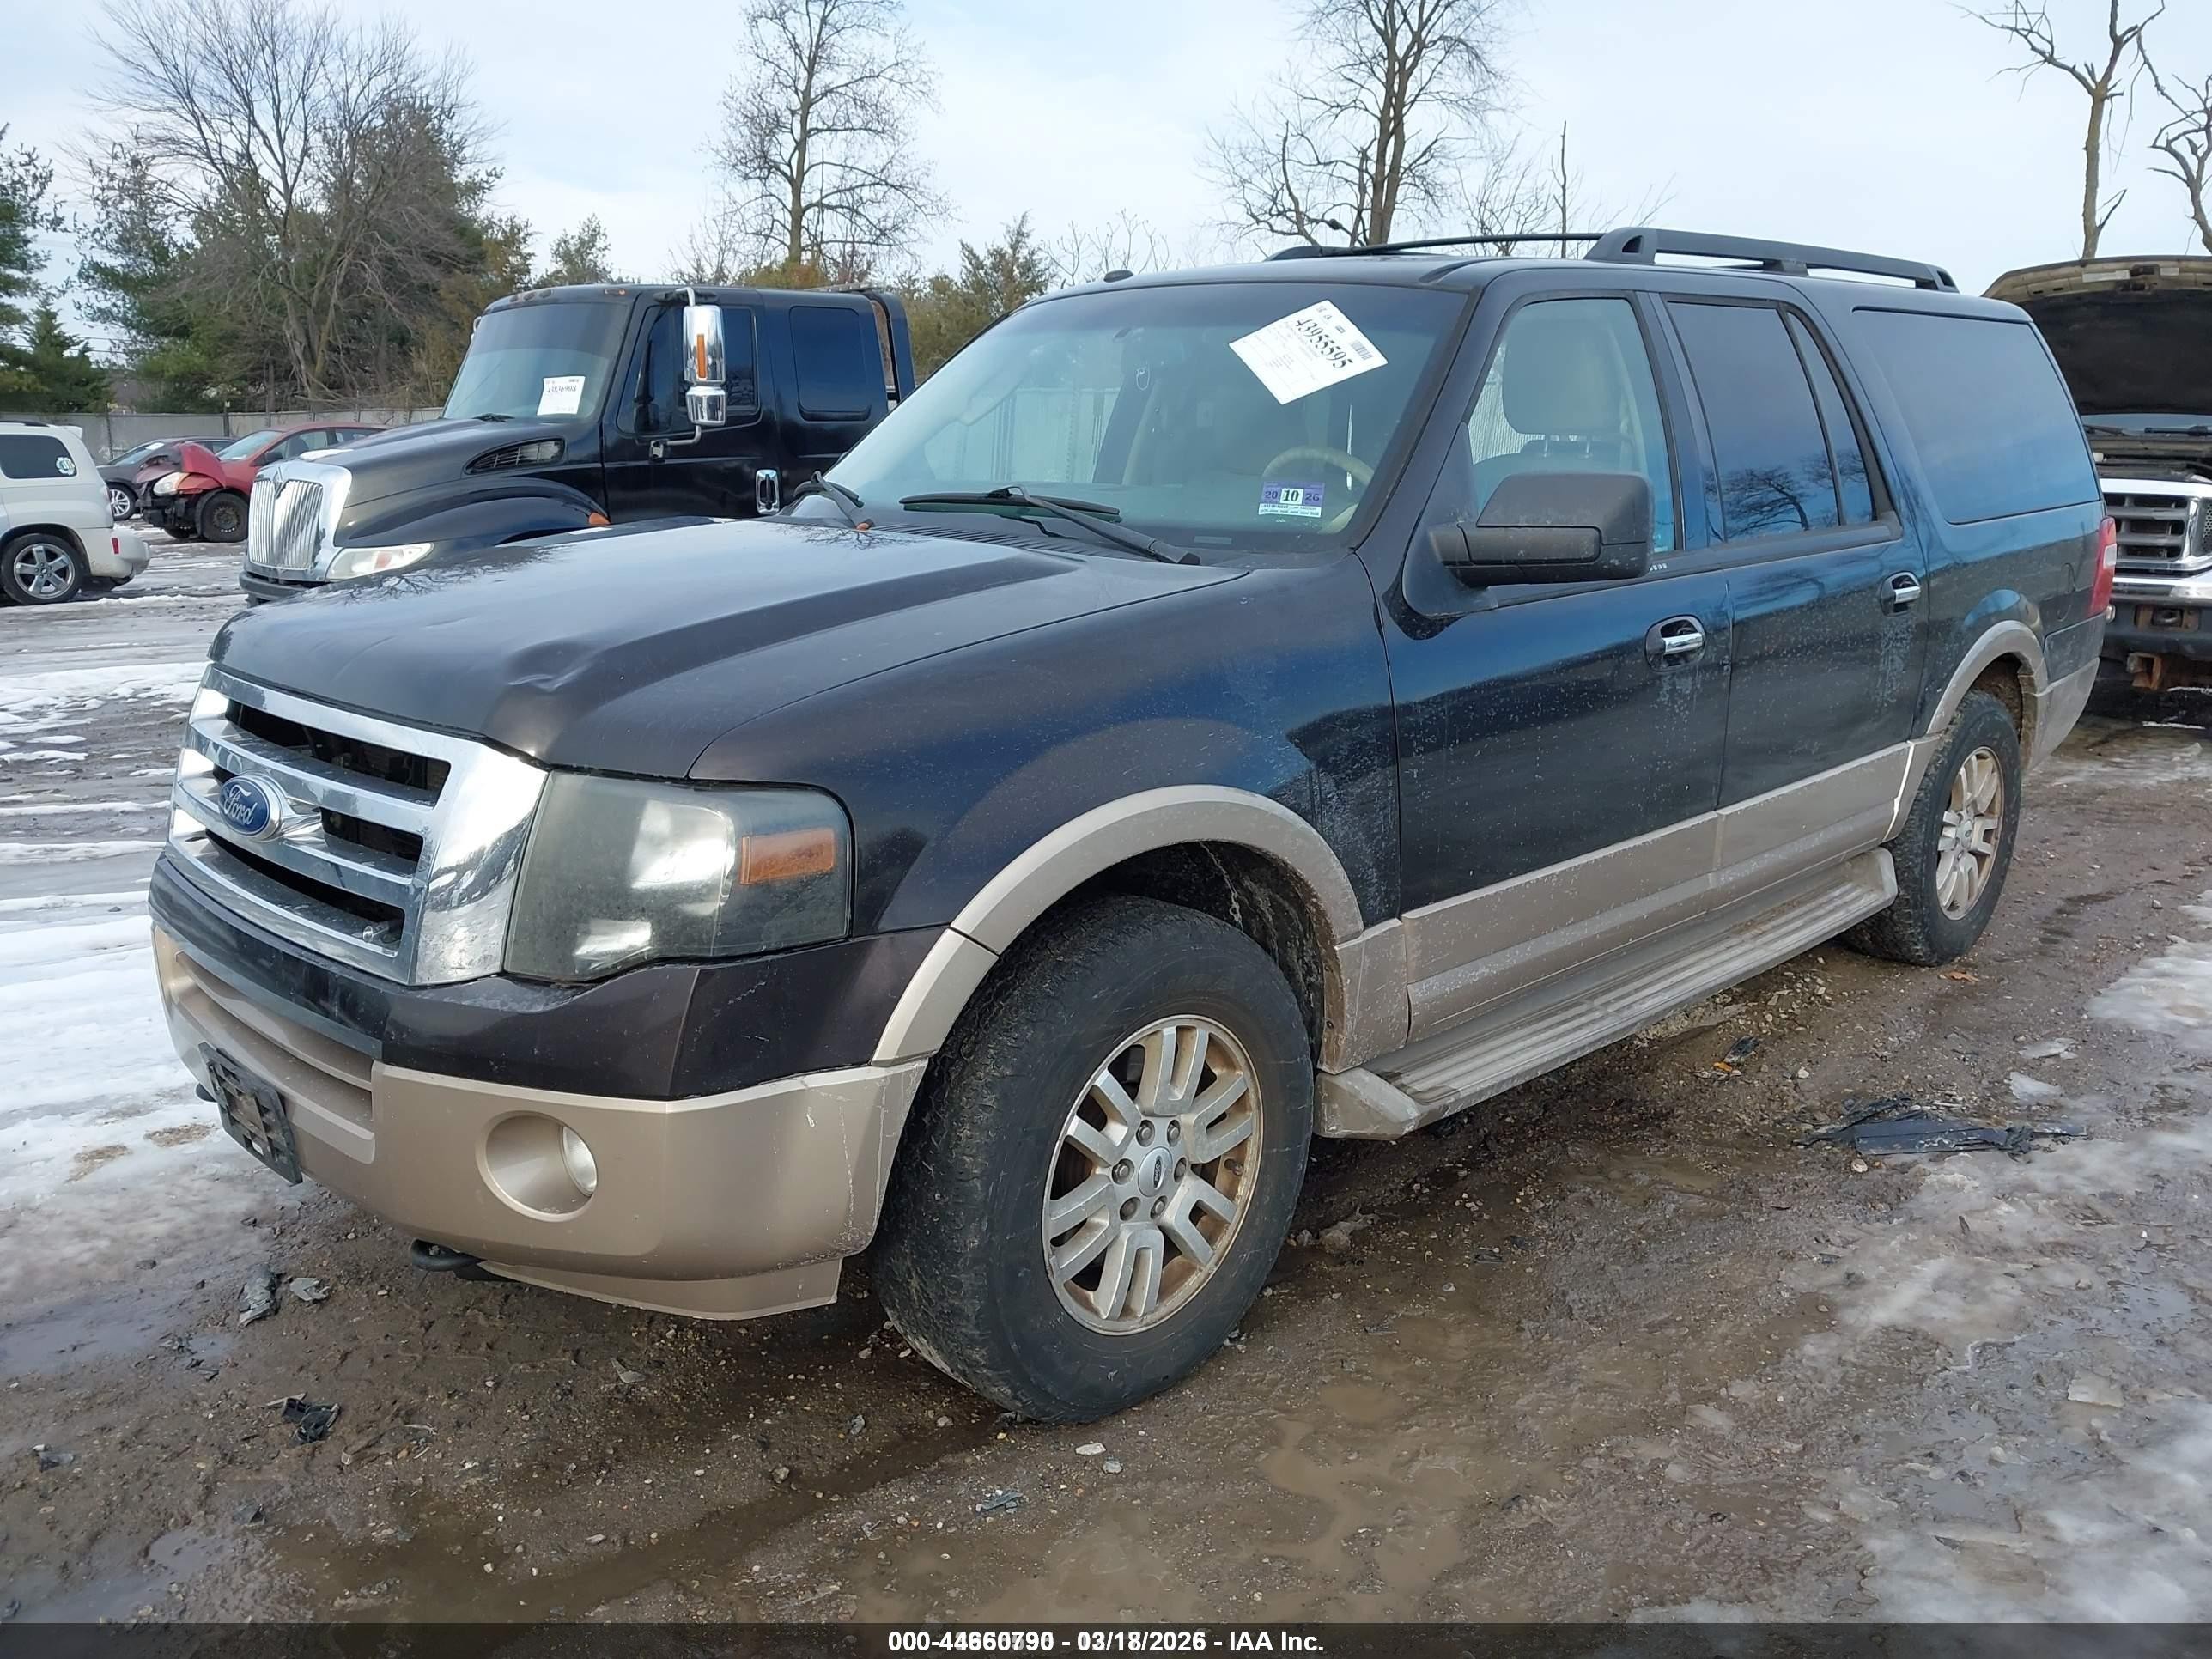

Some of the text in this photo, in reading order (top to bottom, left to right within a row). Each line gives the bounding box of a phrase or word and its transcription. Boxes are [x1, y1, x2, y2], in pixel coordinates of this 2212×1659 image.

[1295, 319, 1353, 369] 43955595
[1265, 489, 1320, 502] 20 10 26
[223, 784, 258, 825] Ford
